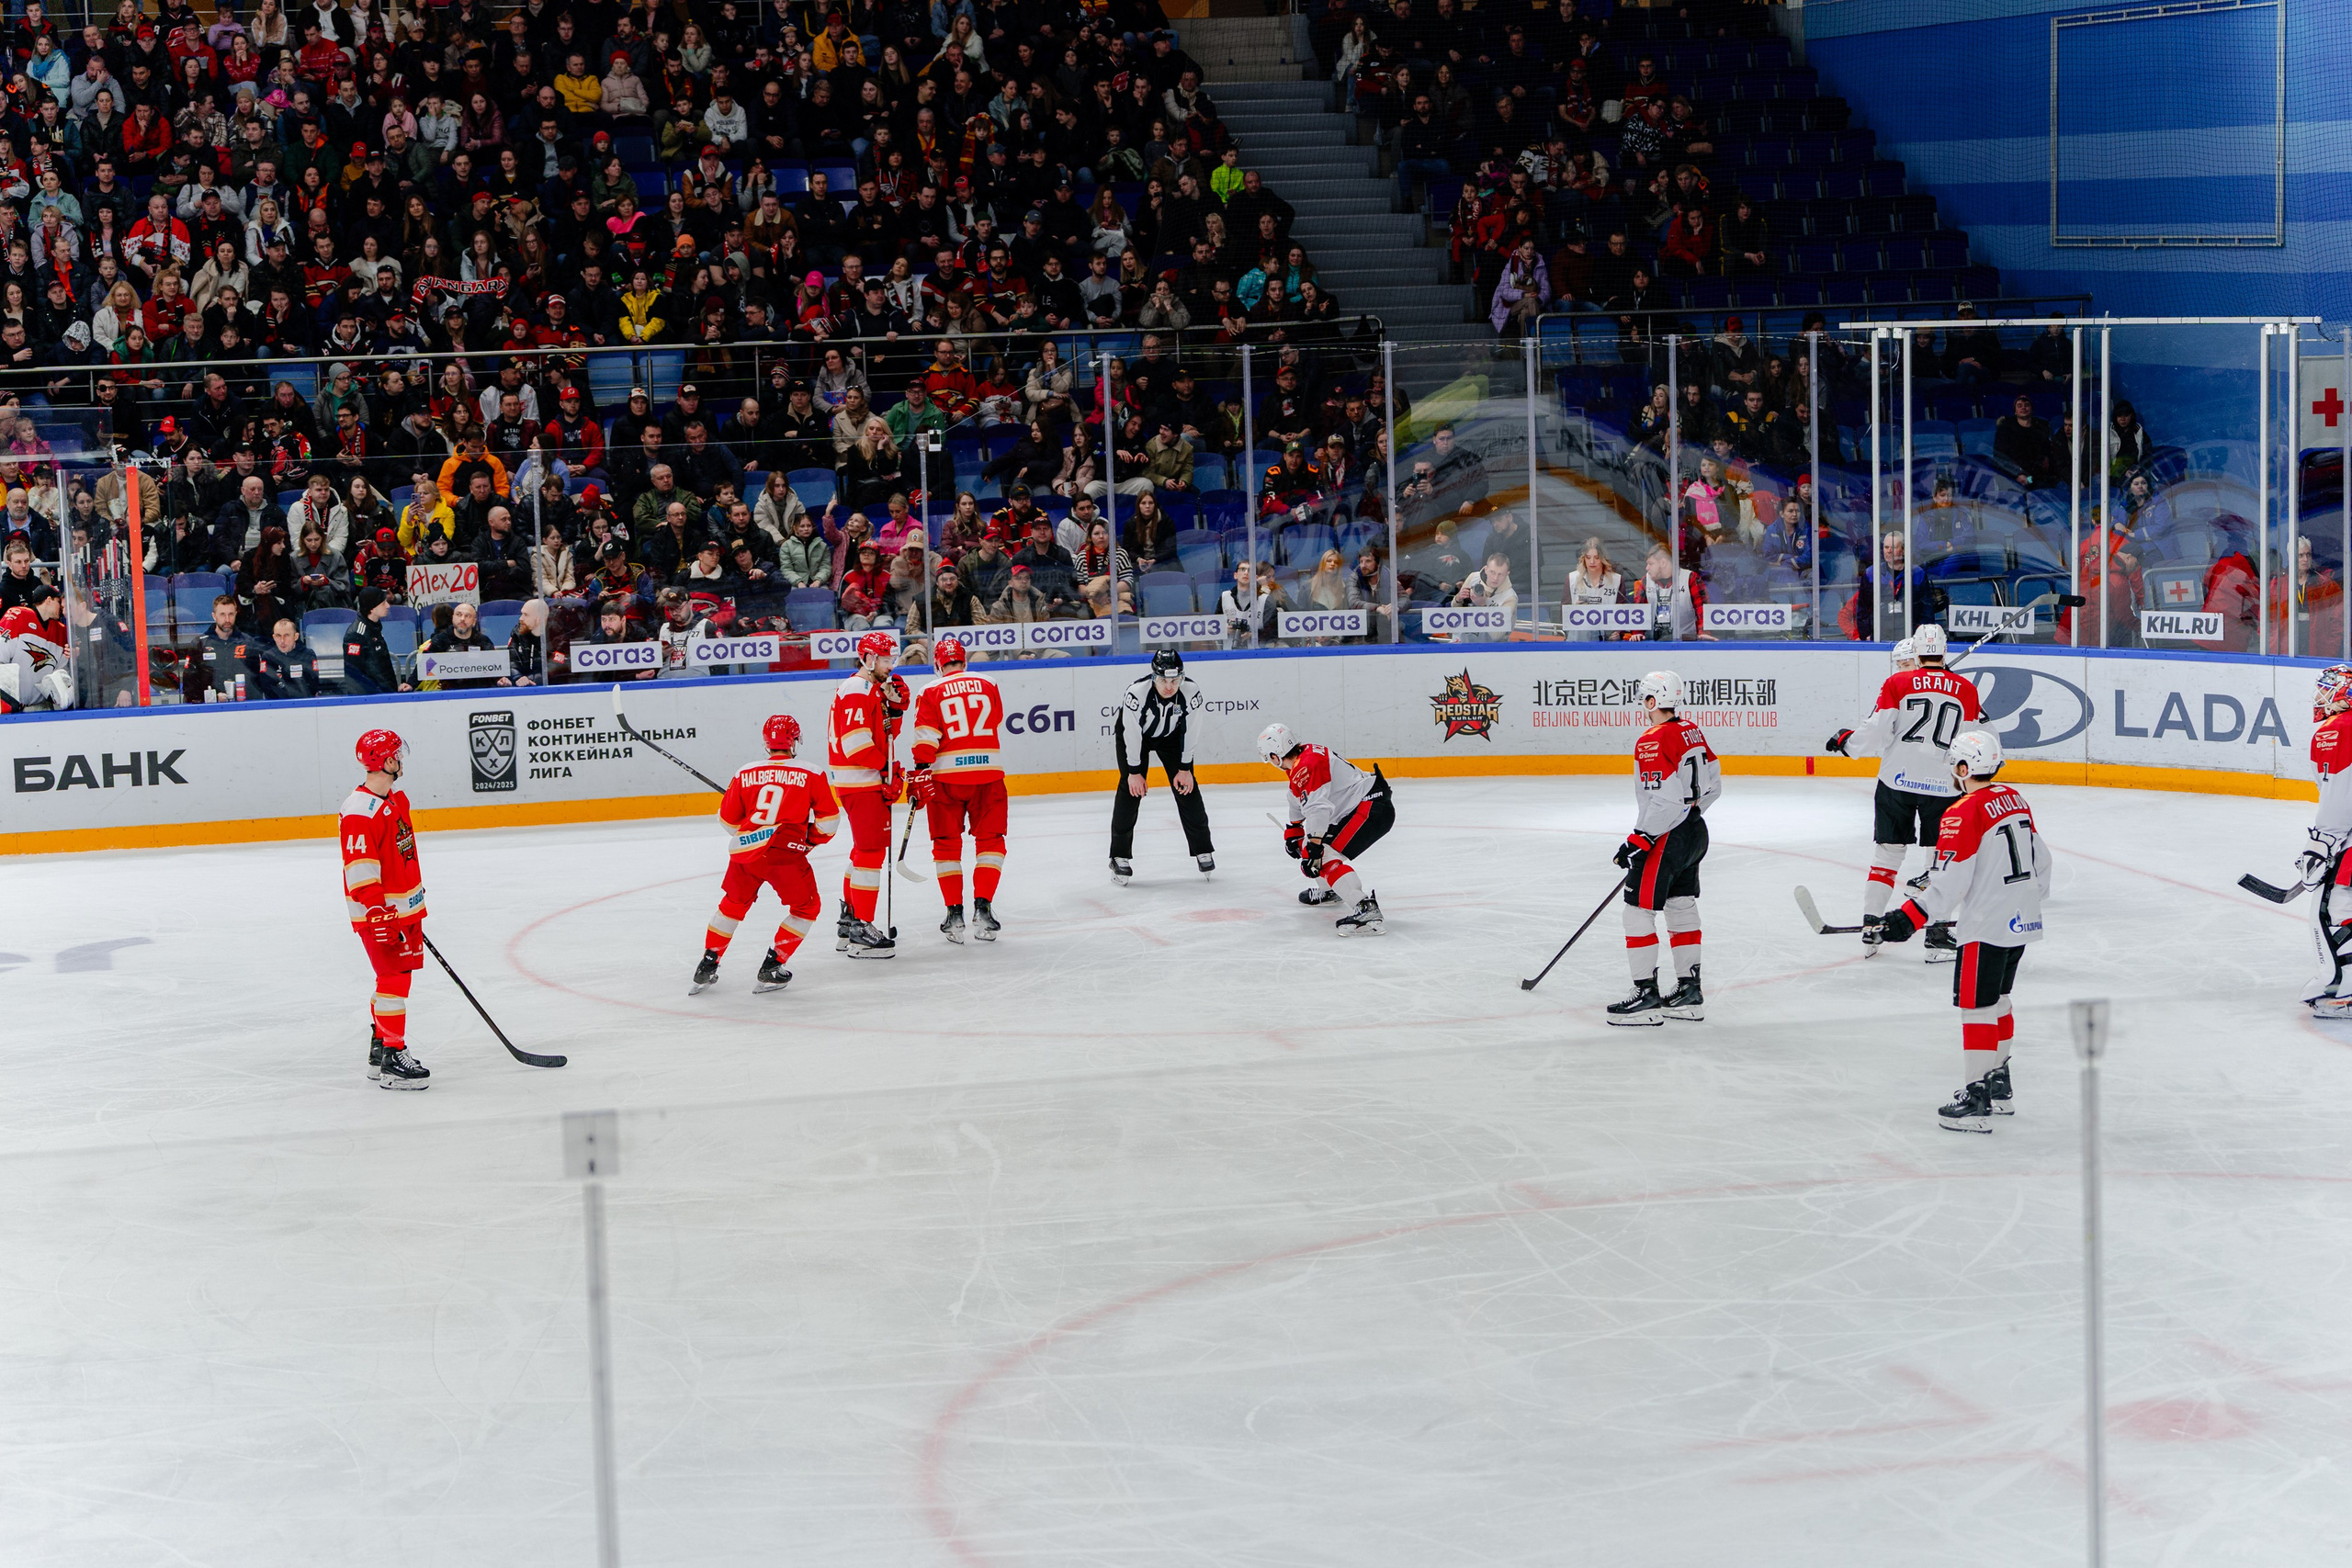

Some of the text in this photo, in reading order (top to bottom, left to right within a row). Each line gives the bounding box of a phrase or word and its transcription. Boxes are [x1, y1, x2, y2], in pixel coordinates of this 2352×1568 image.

[1285, 615, 1361, 633] согаз
[1429, 612, 1505, 628] согаз
[1569, 609, 1645, 626] согаз
[1710, 609, 1785, 626] согаз
[1954, 610, 2030, 629] KHL.RU
[2146, 615, 2218, 635] KHL.RU
[1030, 625, 1105, 643] согаз
[1147, 619, 1221, 638] согаз
[578, 647, 655, 666] согаз
[695, 640, 773, 660] согаз
[439, 662, 503, 675] Ростелеком
[943, 680, 982, 697] JURCO
[1532, 678, 1777, 706] 北京昆仑鸿球俱乐部
[1912, 676, 1962, 696] GRANT
[472, 714, 511, 724] FONBET
[526, 716, 595, 731] ФОНБЕТ
[844, 706, 865, 726] 74
[940, 694, 994, 740] 92
[1005, 704, 1075, 735] сбп
[1430, 703, 1503, 726] REDSTAR
[1532, 711, 1579, 728] BEIJING
[1583, 711, 1631, 727] KUNLUN
[1696, 711, 1744, 727] HOCKEY
[1747, 711, 1778, 727] CLUB
[1902, 698, 1963, 750] 20
[2115, 690, 2292, 747] LADA
[527, 728, 696, 747] КОНТИНЕНТАЛЬНАЯ
[528, 746, 633, 763] ХОККЕЙНАЯ
[956, 755, 989, 767] SIBUR
[14, 749, 189, 794] БАНК
[529, 766, 572, 780] ЛИГА
[741, 769, 808, 788] HALBGEWACHS
[907, 774, 932, 784] CCM
[1640, 771, 1661, 791] 13
[475, 781, 514, 790] 2024/2025
[750, 784, 785, 826] 9
[346, 834, 367, 854] 44
[739, 829, 775, 846] SIBUR
[1929, 851, 1956, 872] 17
